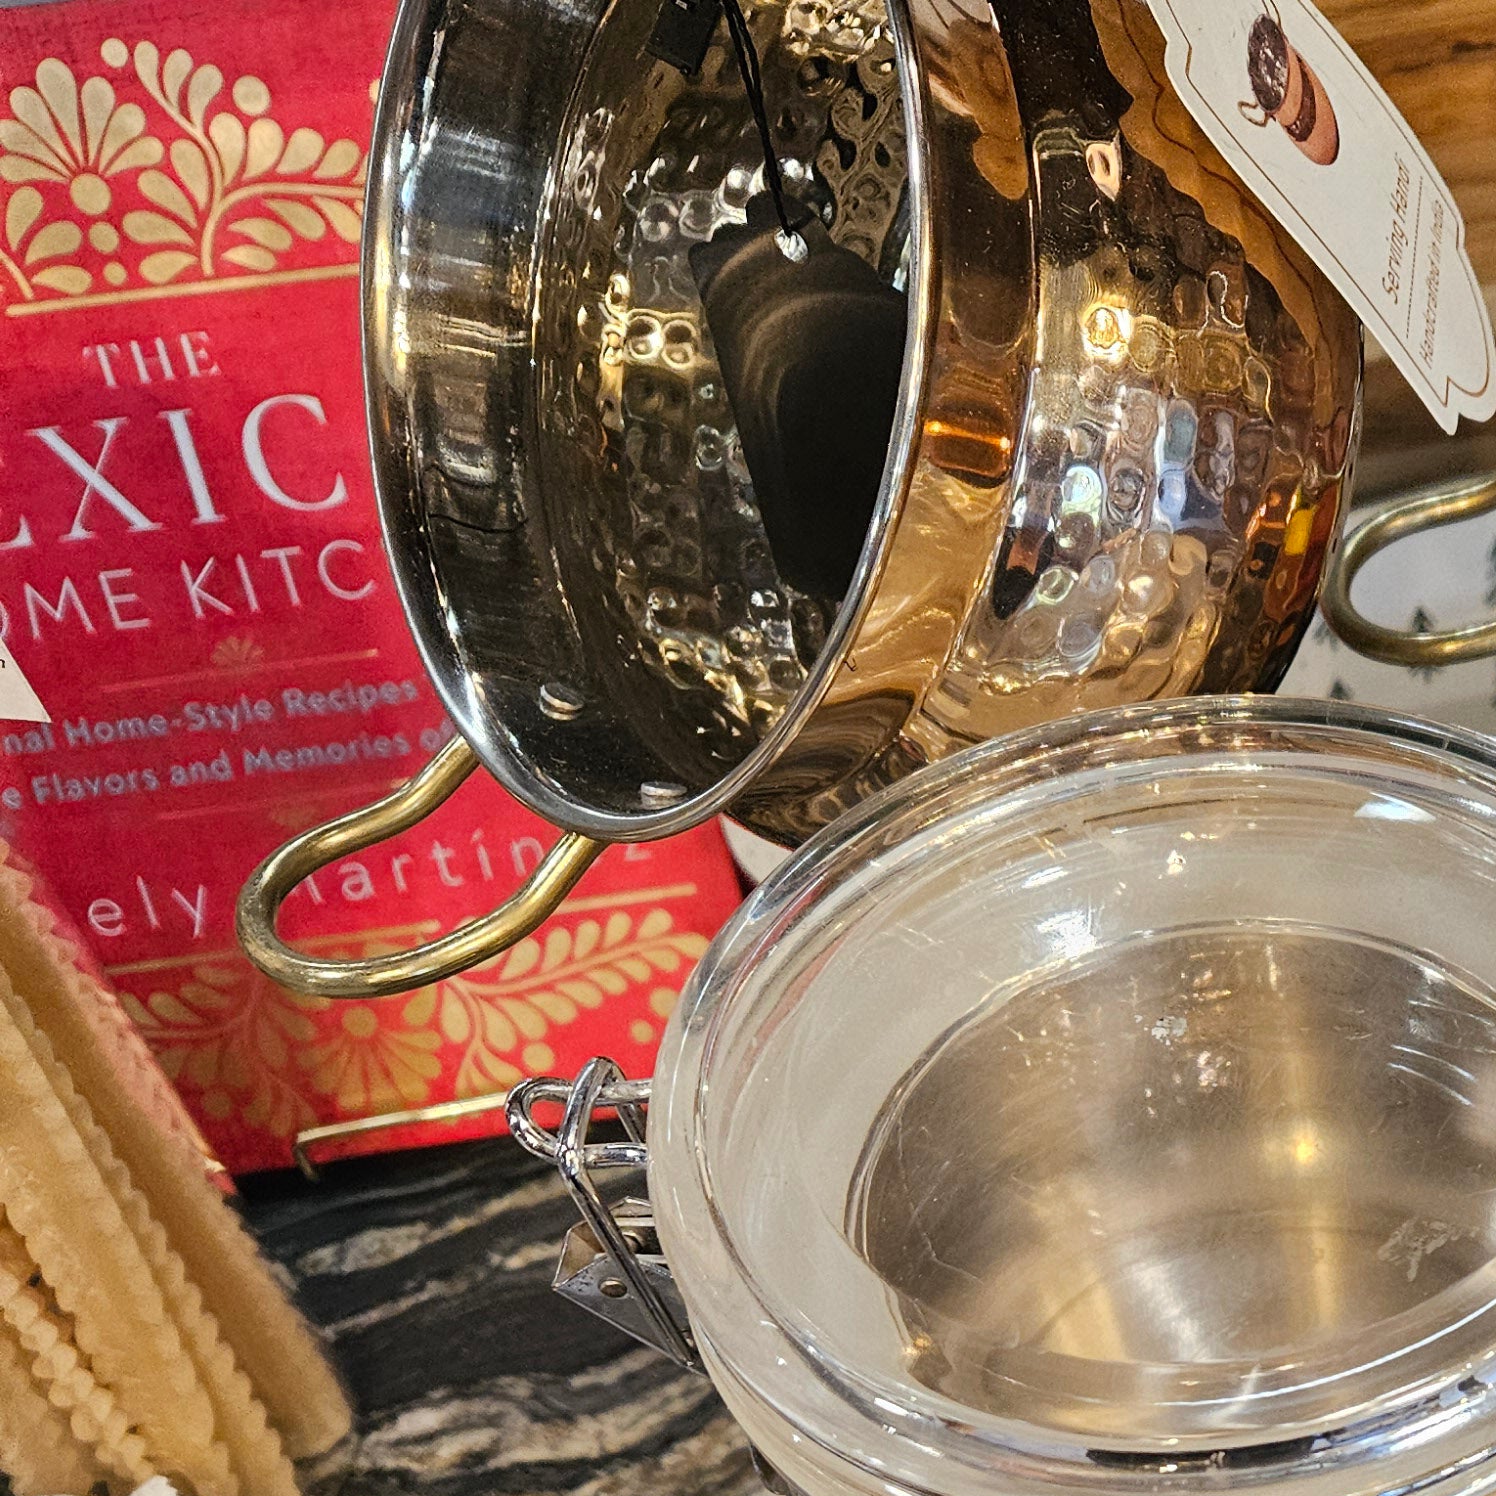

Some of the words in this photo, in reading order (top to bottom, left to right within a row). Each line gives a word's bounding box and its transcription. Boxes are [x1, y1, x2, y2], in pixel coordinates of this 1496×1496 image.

[1390, 152, 1409, 223] Handi
[1382, 218, 1408, 305] Serving
[1419, 254, 1440, 370] Handcrafted
[82, 330, 222, 390] THE
[0, 393, 350, 550] XIC
[180, 539, 377, 619] KITC
[62, 693, 275, 748] Home-Style
[281, 679, 419, 720] Recipes
[31, 772, 161, 805] Flavors
[170, 749, 234, 787] and
[243, 730, 412, 777] Memories
[87, 875, 209, 940] ely
